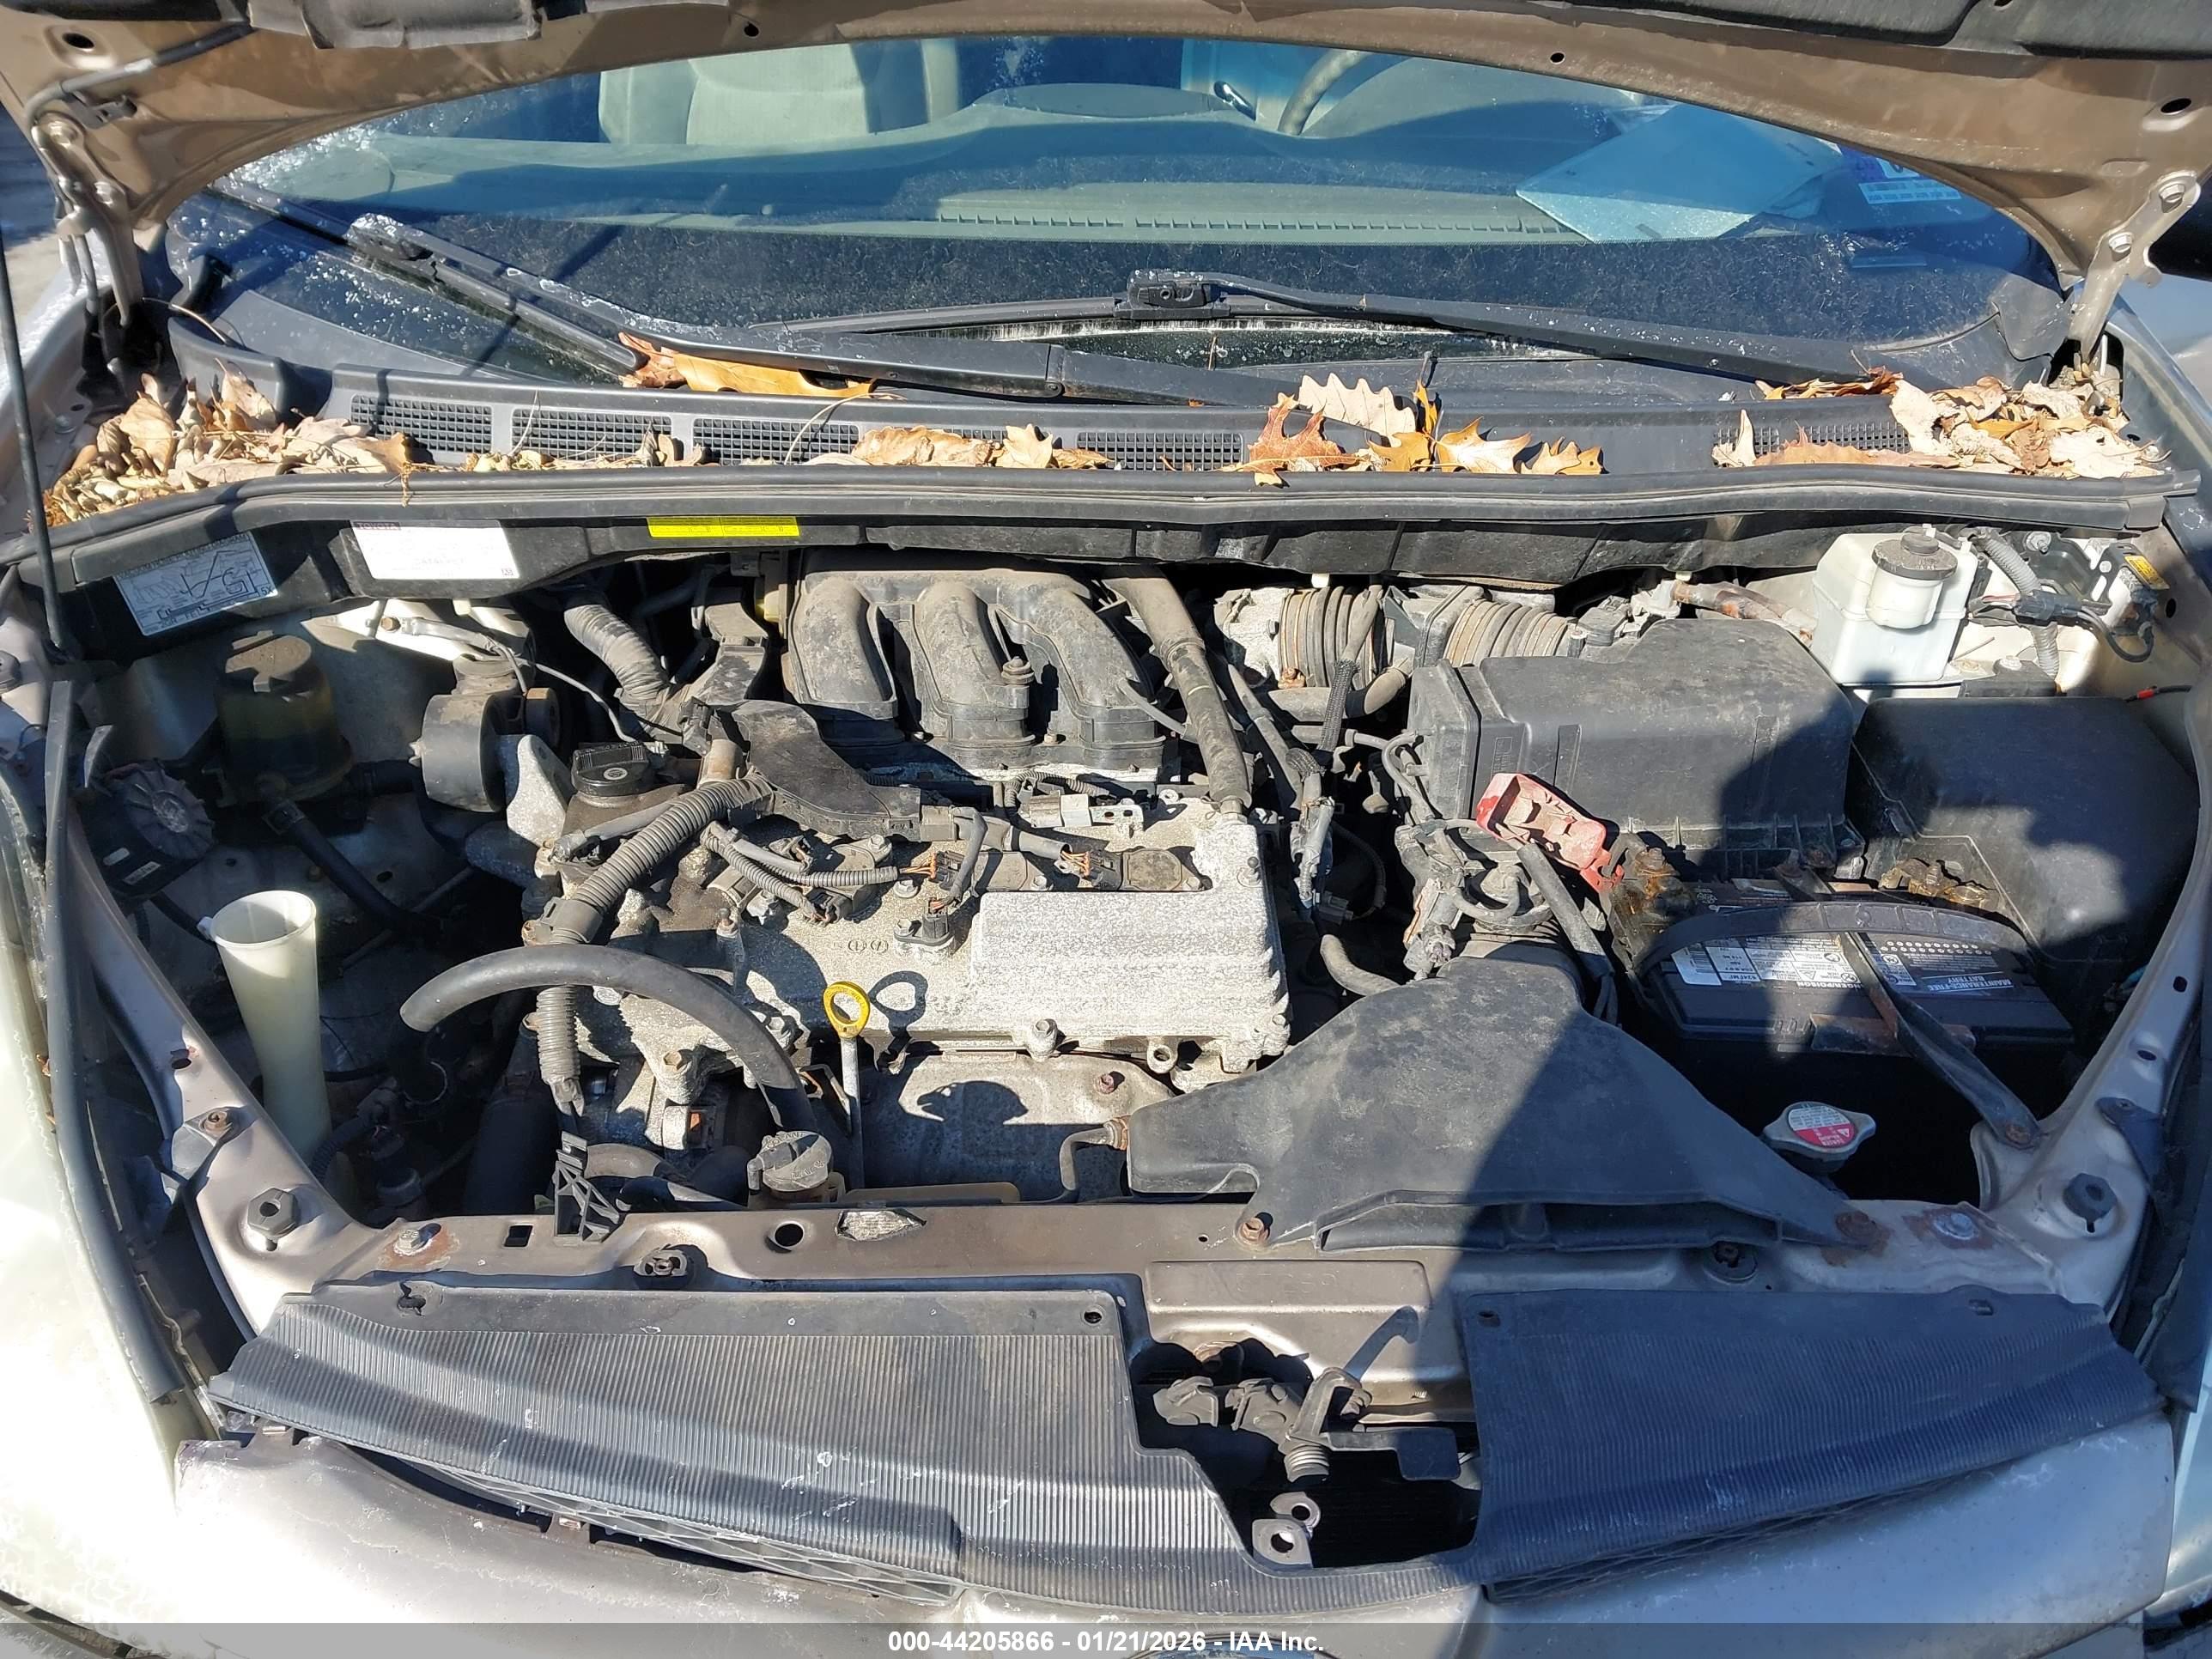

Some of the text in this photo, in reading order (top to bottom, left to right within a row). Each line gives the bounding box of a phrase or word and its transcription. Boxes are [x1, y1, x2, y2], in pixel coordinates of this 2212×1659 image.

[357, 522, 399, 531] TOYOTA
[261, 586, 274, 596] 5X
[1948, 975, 1985, 984] BATTERY
[1926, 978, 2013, 991] MAINTENANCE-FREE
